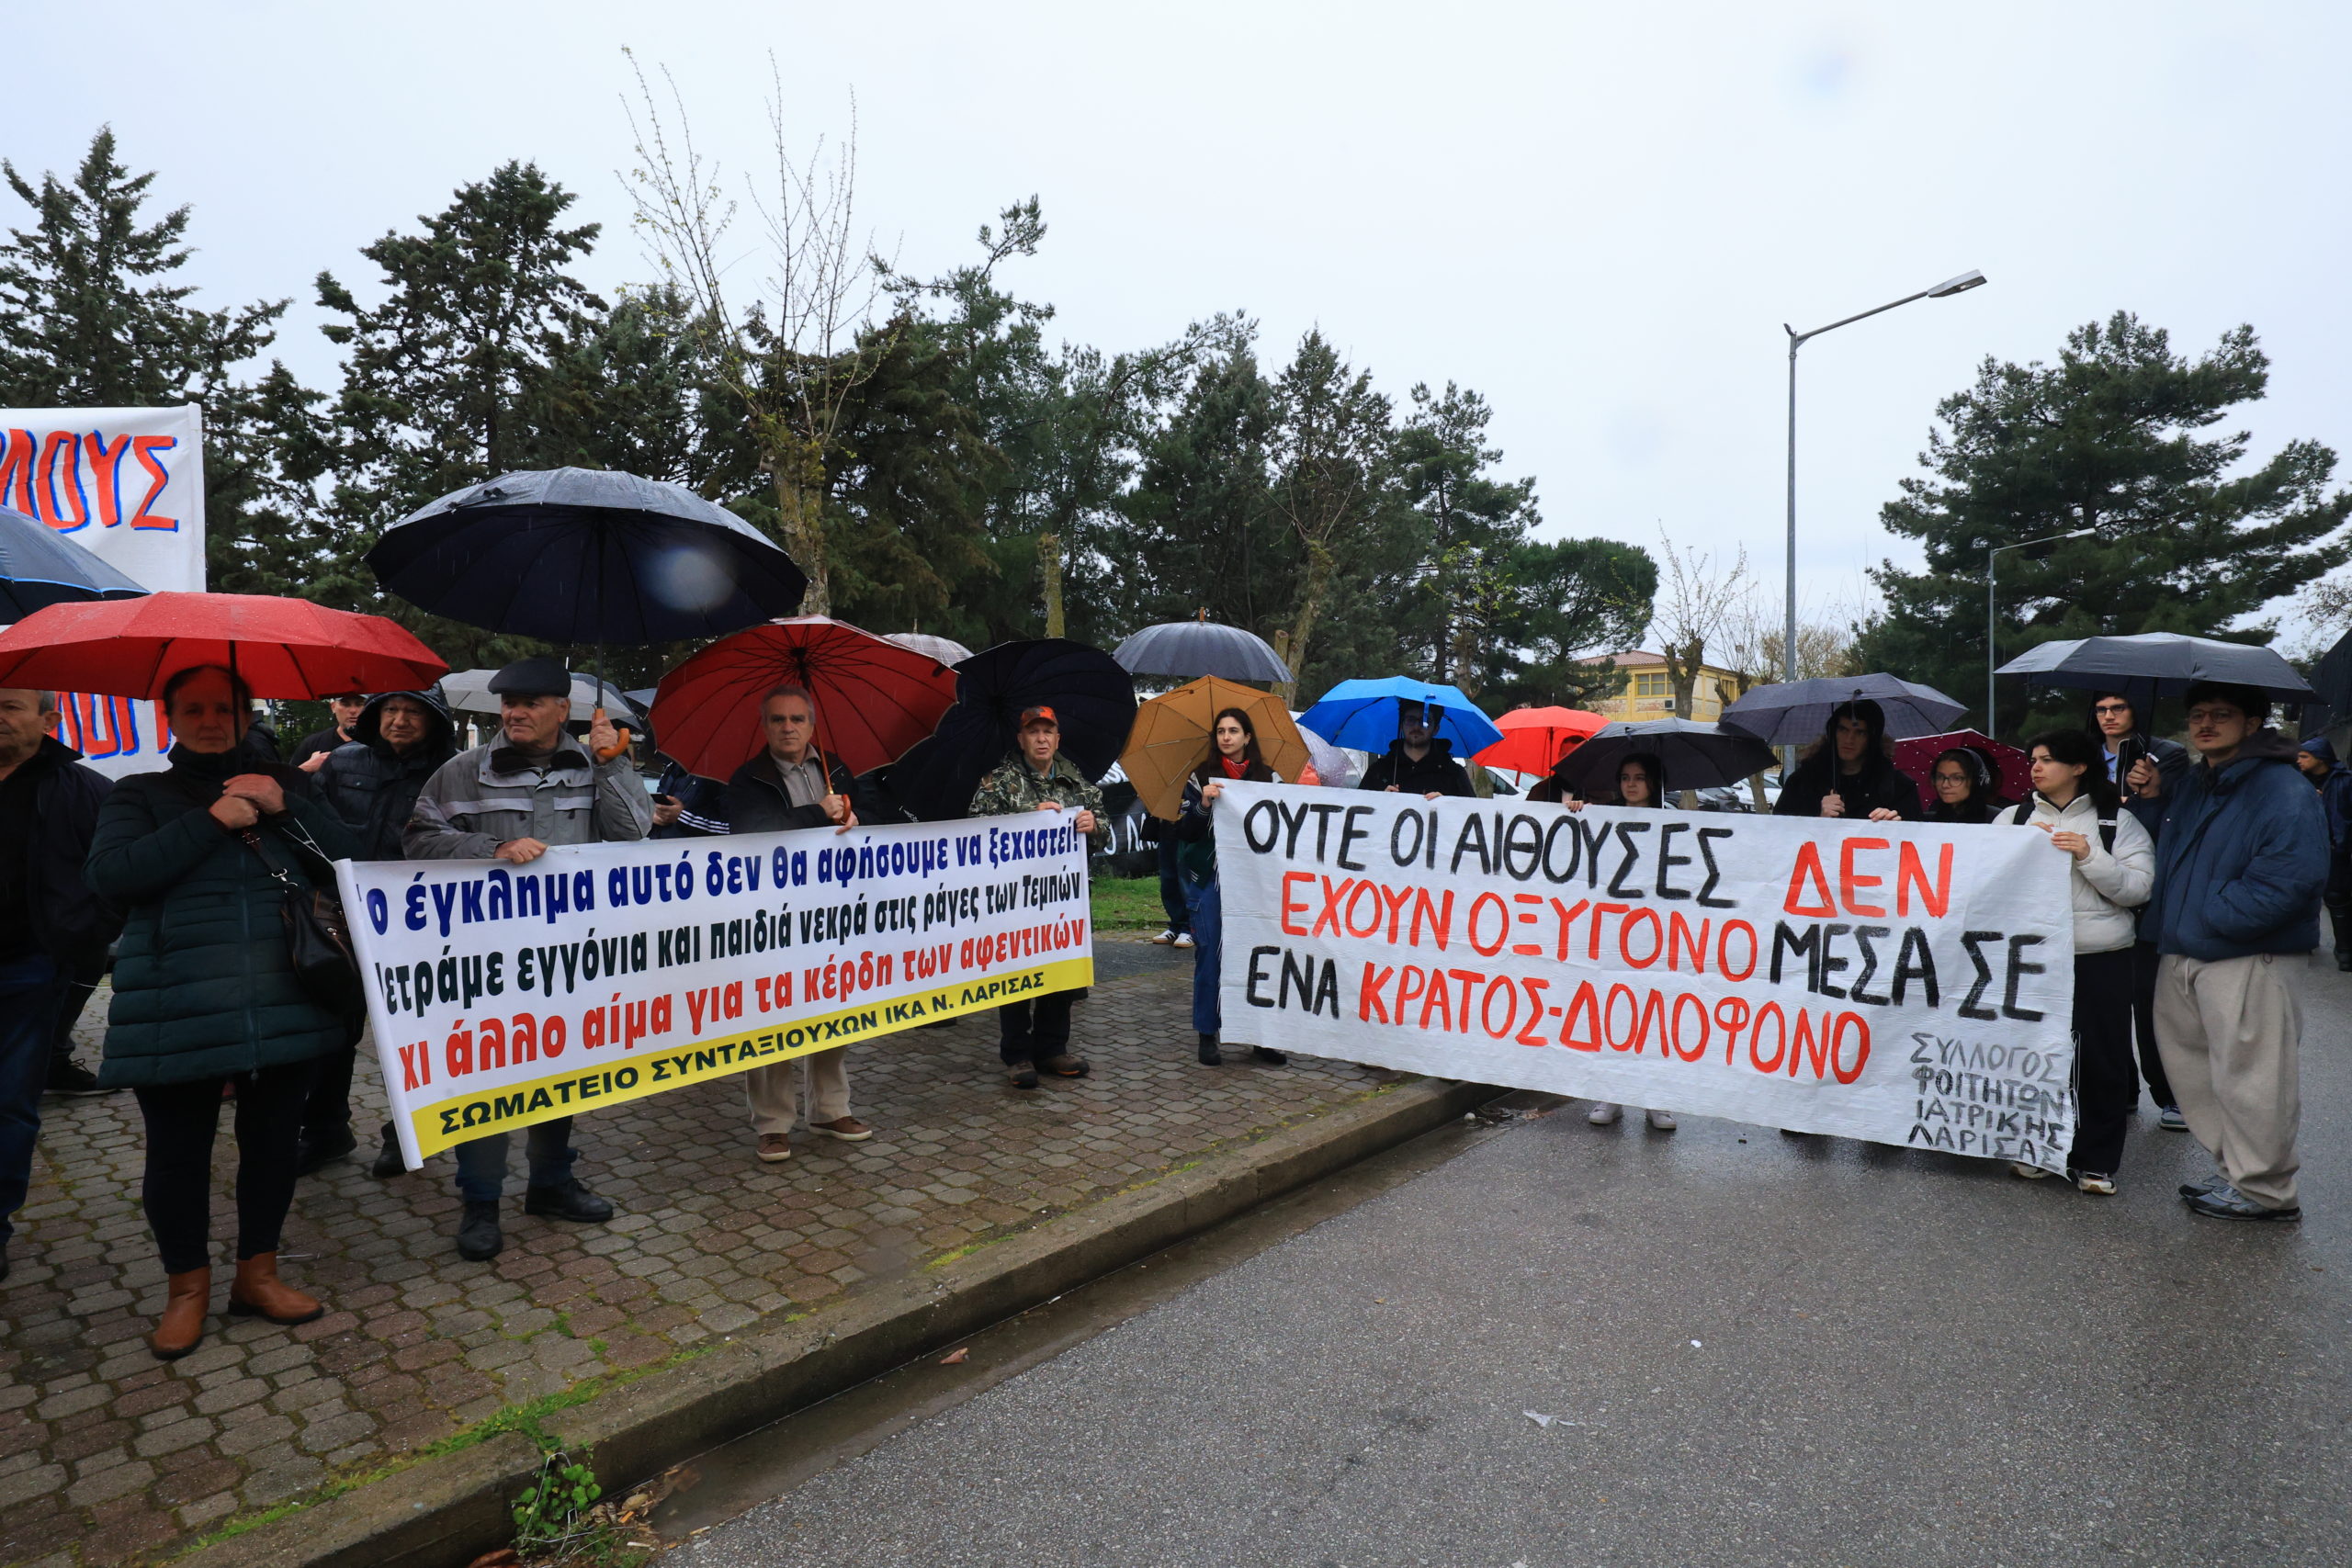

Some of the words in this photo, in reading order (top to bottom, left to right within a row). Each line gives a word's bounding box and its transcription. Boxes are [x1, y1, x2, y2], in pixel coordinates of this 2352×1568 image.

[0, 429, 178, 534] ΛΟΥΣ
[356, 884, 388, 935] ο
[404, 868, 594, 937] έγκλημα
[608, 851, 694, 908] αυτό
[706, 851, 761, 896] δεν
[773, 845, 807, 889] θα
[818, 837, 948, 887] αφήσουμε
[956, 832, 981, 869] να
[989, 819, 1078, 871] ξεχαστεί!
[1244, 799, 1375, 871] ΟΥΤΕ
[1391, 807, 1438, 870] ΟΙ
[1450, 810, 1738, 908] ΑΙΘΟΥΣΕΣ
[1783, 838, 1953, 919] ΔΕΝ
[375, 945, 503, 1018] ετράμε
[517, 928, 647, 997] εγγόνια
[658, 925, 700, 968] και
[710, 903, 791, 959] παιδιά
[800, 894, 867, 946] νεκρά
[875, 895, 917, 934] στις
[924, 881, 978, 931] ράγες
[986, 877, 1018, 914] των
[1023, 865, 1080, 908] Τεμπών
[1246, 945, 1340, 1020] ΕΝΑ
[1281, 871, 1454, 951] ΕΧΟΥΝ
[1468, 891, 1758, 982] ΟΞΥΓΟΝΟ
[1770, 919, 1939, 1009] ΜΕΣΑ
[1958, 931, 2047, 1022] ΣΕ
[399, 1041, 432, 1092] χι
[446, 1019, 566, 1077] άλλο
[582, 993, 672, 1050] αίμα
[685, 983, 742, 1035] για
[755, 971, 792, 1013] τα
[805, 954, 893, 1002] κέρδη
[903, 942, 952, 979] των
[960, 913, 1084, 972] αφεντικών
[439, 1066, 639, 1134] ΣΩΜΑΤΕΙΟ
[651, 1010, 877, 1081] ΣΥΝΤΑΞΙΟΥΧΩΝ
[886, 1000, 926, 1024] ΙΚΑ
[932, 994, 954, 1014] Ν.
[961, 972, 1045, 1007] ΛΑΡΙΣΑΣ
[1910, 1032, 2064, 1083] ΣΥΛΛΟΓΟΣ
[1908, 1122, 2060, 1170] ΛΑΡΙΣΑΣ
[1912, 1065, 2064, 1118] ΦΟΙΤΗΤΩΝ
[1916, 1096, 2064, 1150] ΙΑΤΡΙΚΗΣ
